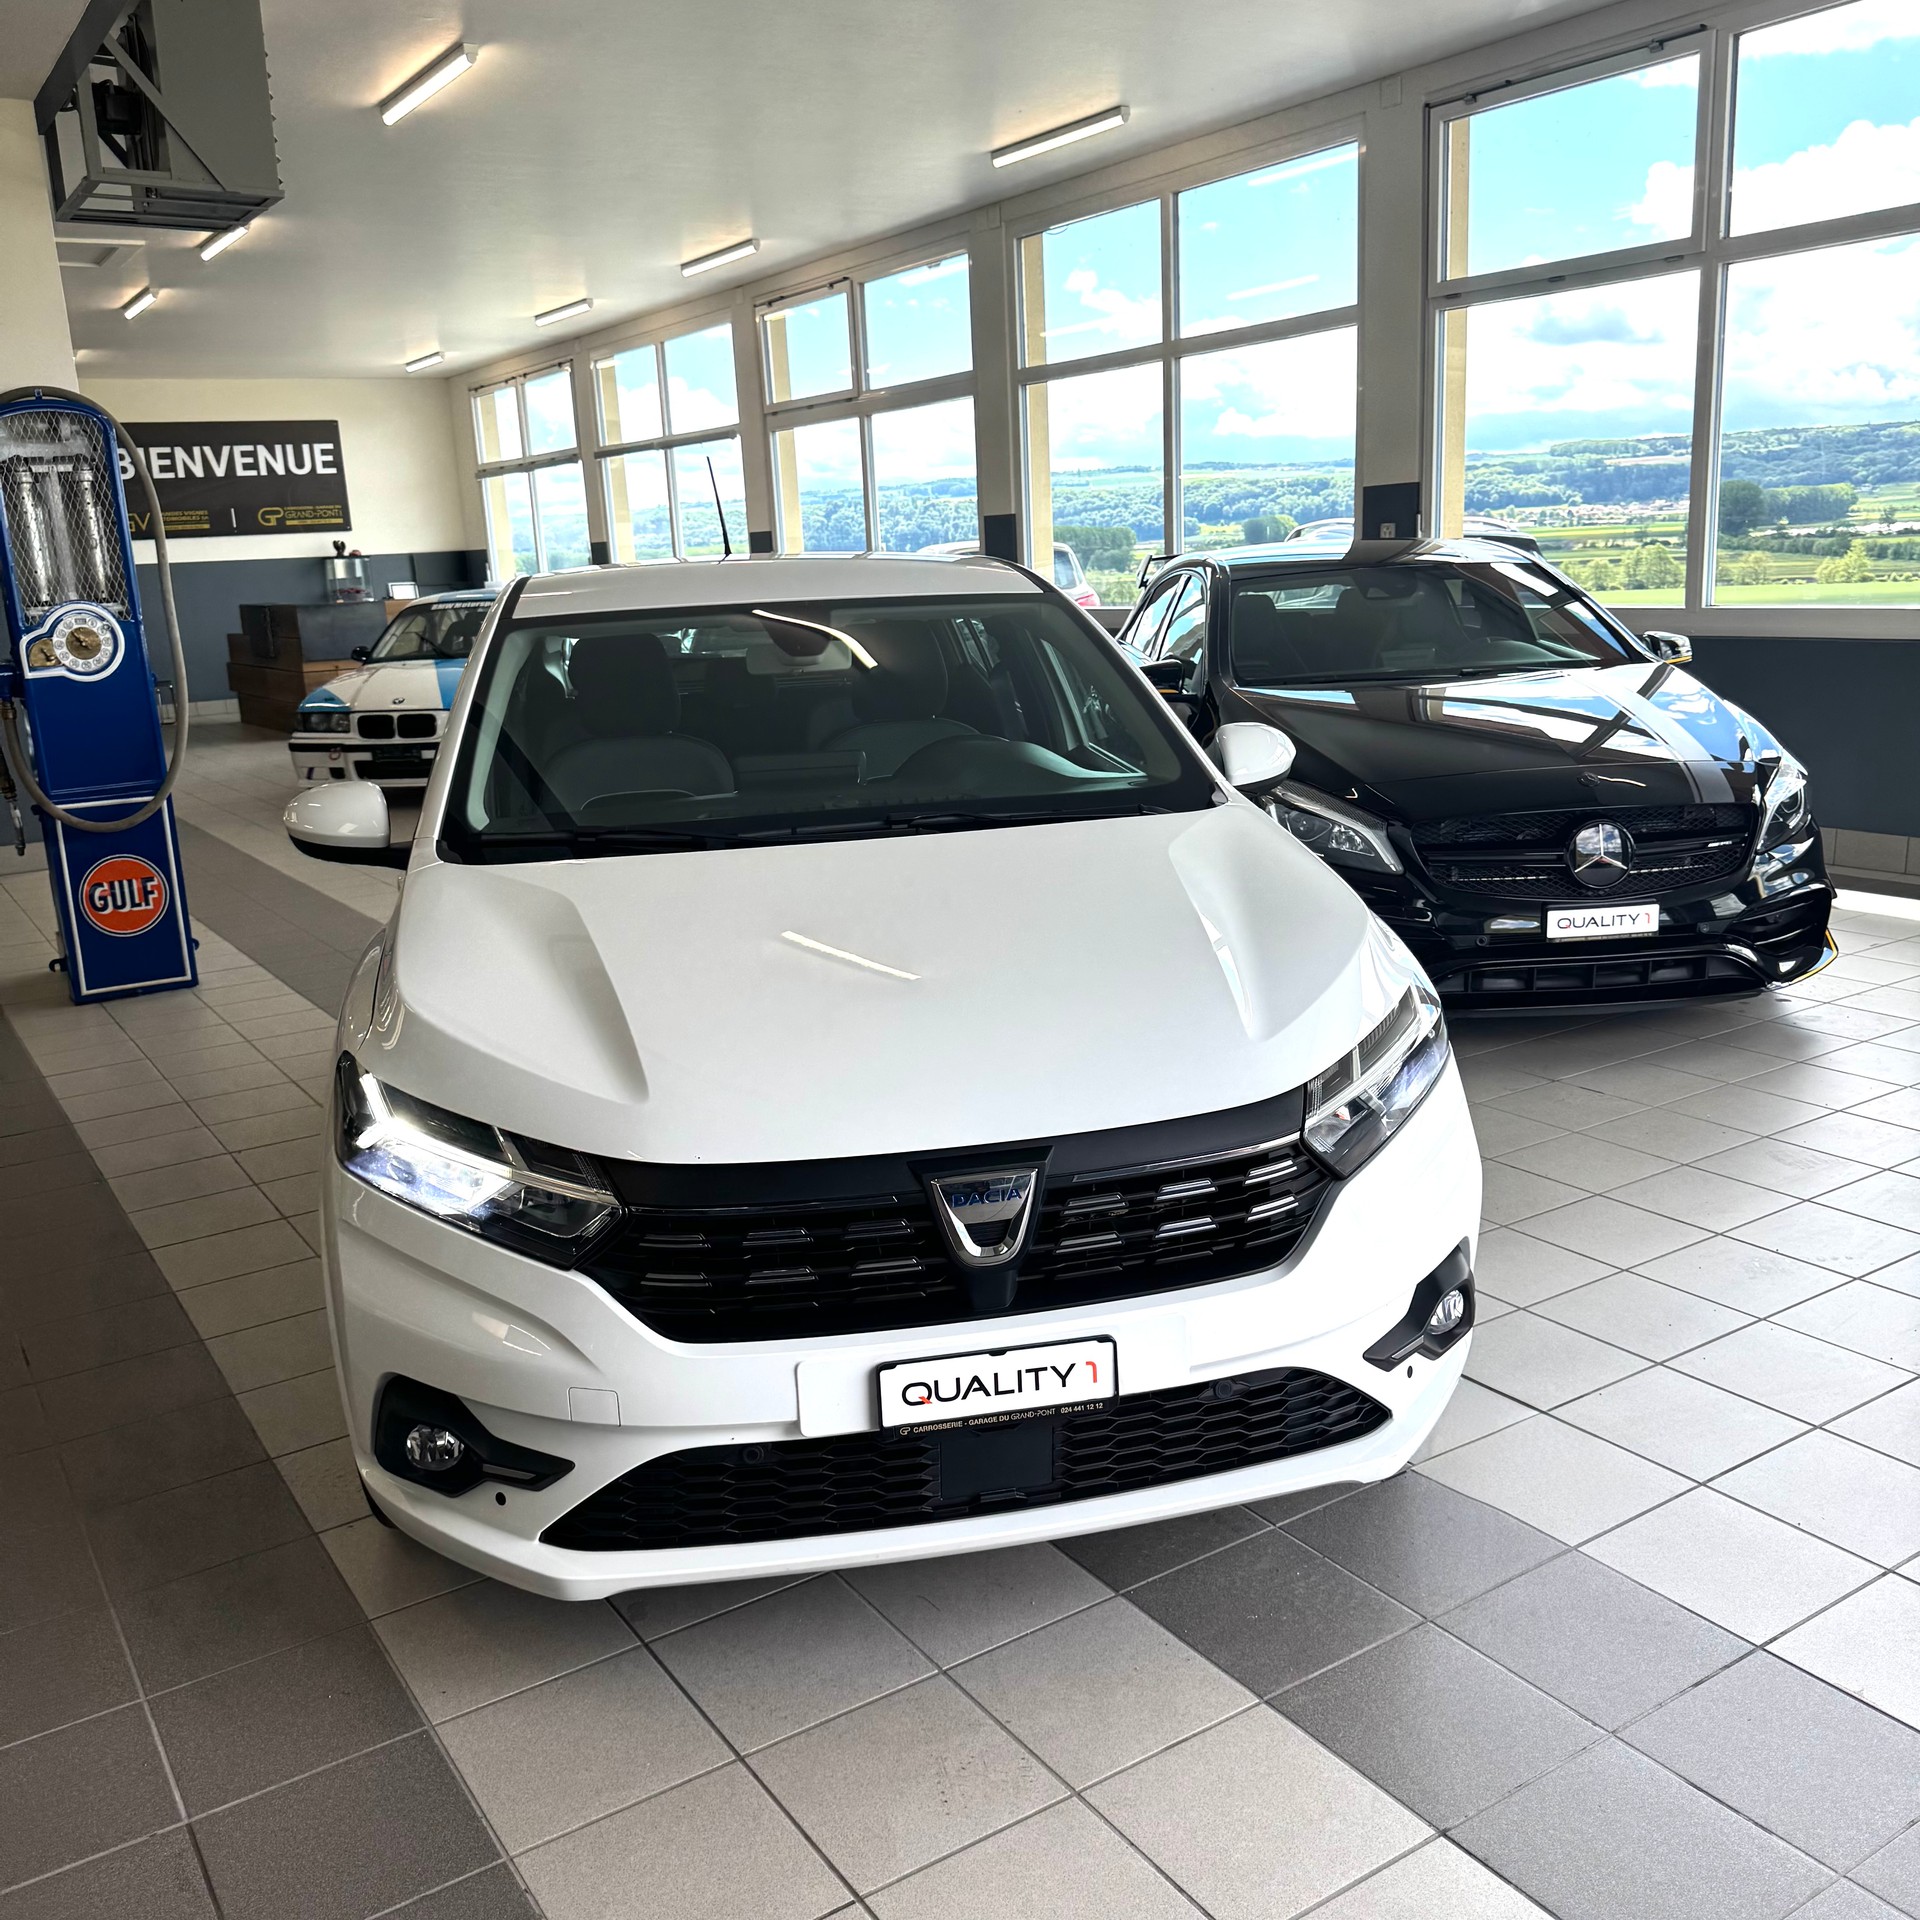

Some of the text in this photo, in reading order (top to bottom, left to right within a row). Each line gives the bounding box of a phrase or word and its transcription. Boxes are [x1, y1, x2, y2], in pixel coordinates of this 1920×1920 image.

[117, 443, 338, 480] BENVENUE
[88, 876, 159, 914] GULF
[1557, 913, 1641, 929] QUALITY
[951, 1189, 1022, 1208] DACIA
[901, 1361, 1098, 1406] QUALITY 1
[913, 1421, 963, 1433] CARROSSERIE
[968, 1416, 998, 1426] GARAGE
[999, 1414, 1010, 1422] DU
[1010, 1408, 1056, 1420] GRAND-PONT
[1060, 1406, 1072, 1414] 024
[1073, 1405, 1085, 1413] 441
